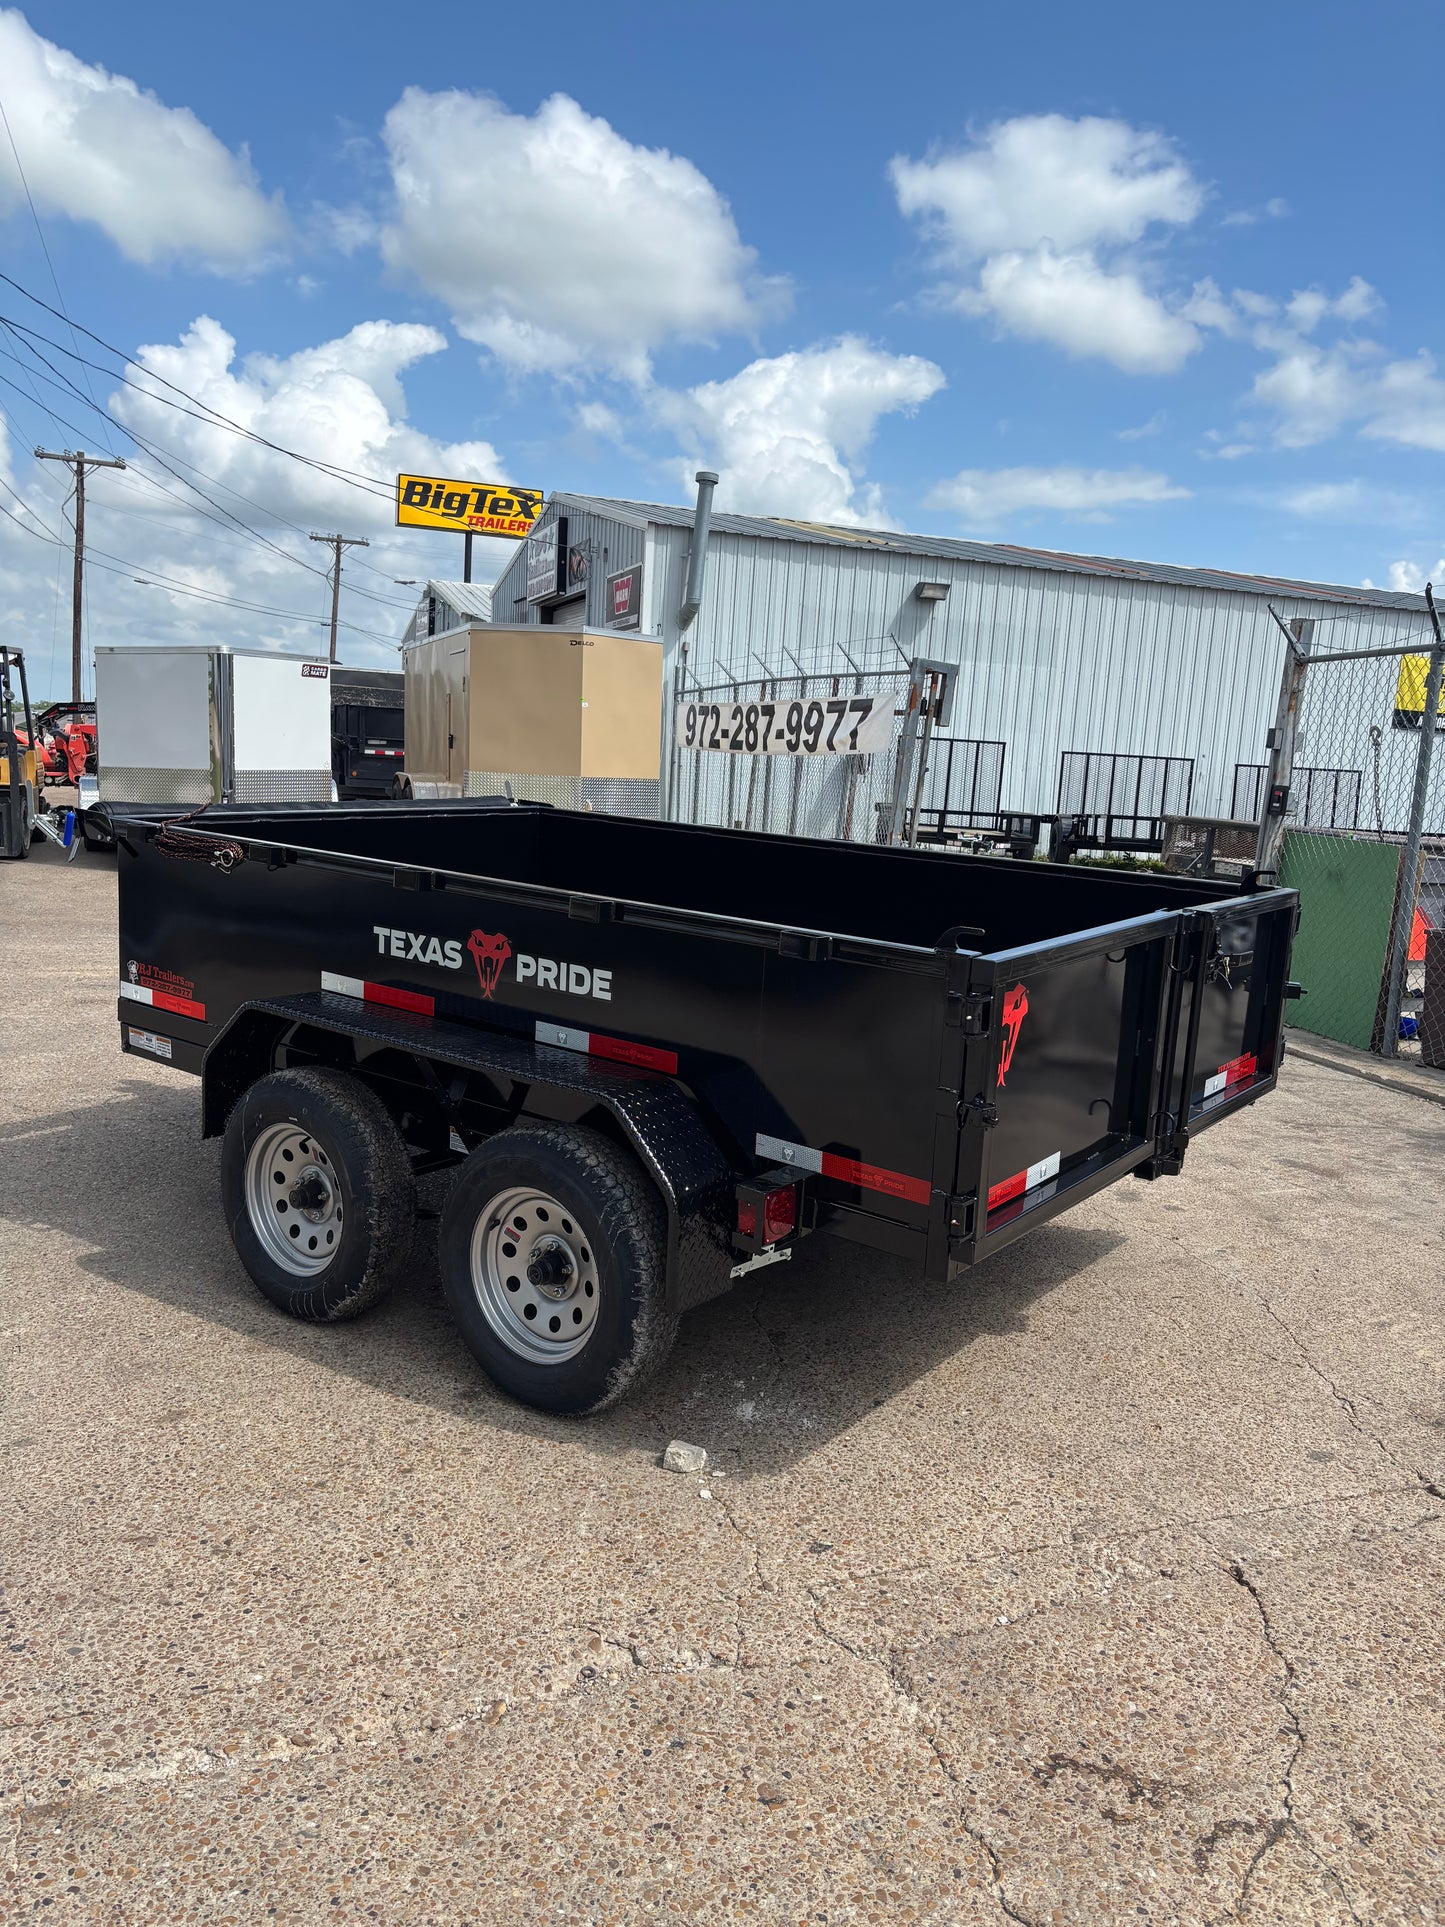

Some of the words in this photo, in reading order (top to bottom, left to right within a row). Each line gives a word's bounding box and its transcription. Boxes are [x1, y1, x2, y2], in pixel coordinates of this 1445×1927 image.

[401, 480, 540, 519] BigTex
[685, 698, 874, 753] 972-287-9977
[138, 963, 152, 976] RJ
[373, 925, 463, 969] TEXAS
[516, 953, 613, 1001] PRIDE
[852, 1171, 873, 1181] TEXAS
[884, 1180, 904, 1191] PRIDE
